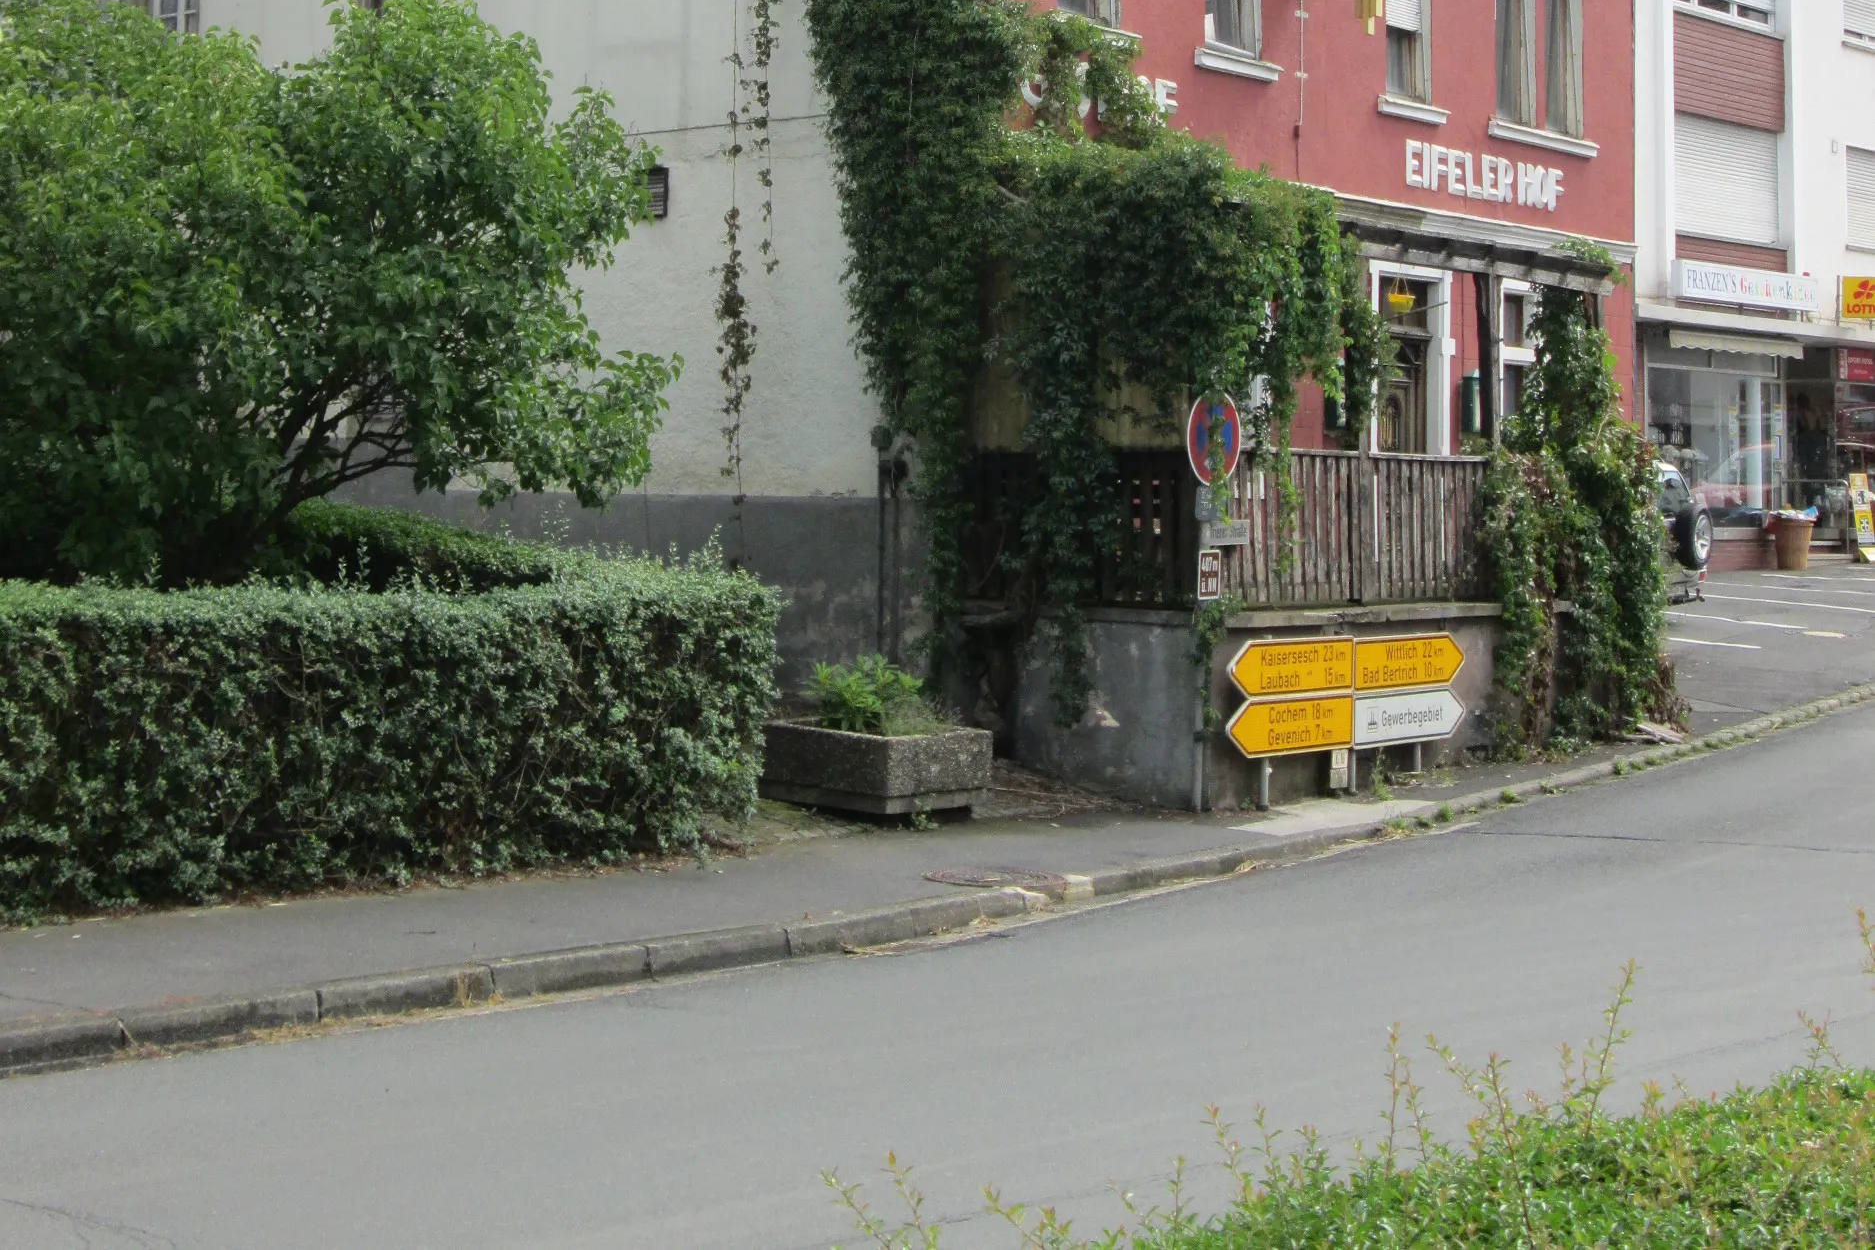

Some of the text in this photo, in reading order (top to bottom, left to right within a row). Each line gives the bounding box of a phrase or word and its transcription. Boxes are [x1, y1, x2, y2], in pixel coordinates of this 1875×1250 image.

[1406, 139, 1565, 212] EIFELER HOF
[1687, 269, 1737, 294] FRANZEN'S
[1846, 303, 1875, 314] LOTT
[1260, 645, 1346, 666] Kaisersesch 23 km
[1385, 642, 1444, 661] Wittlich 22 km
[1260, 667, 1345, 690] Laubach 15 km
[1362, 661, 1444, 683] Bad Bertrich 10 km
[1268, 703, 1333, 724] Cochem 18 km
[1381, 705, 1443, 727] Gewerbegebiet
[1268, 724, 1333, 746] Gevenich 7 km
